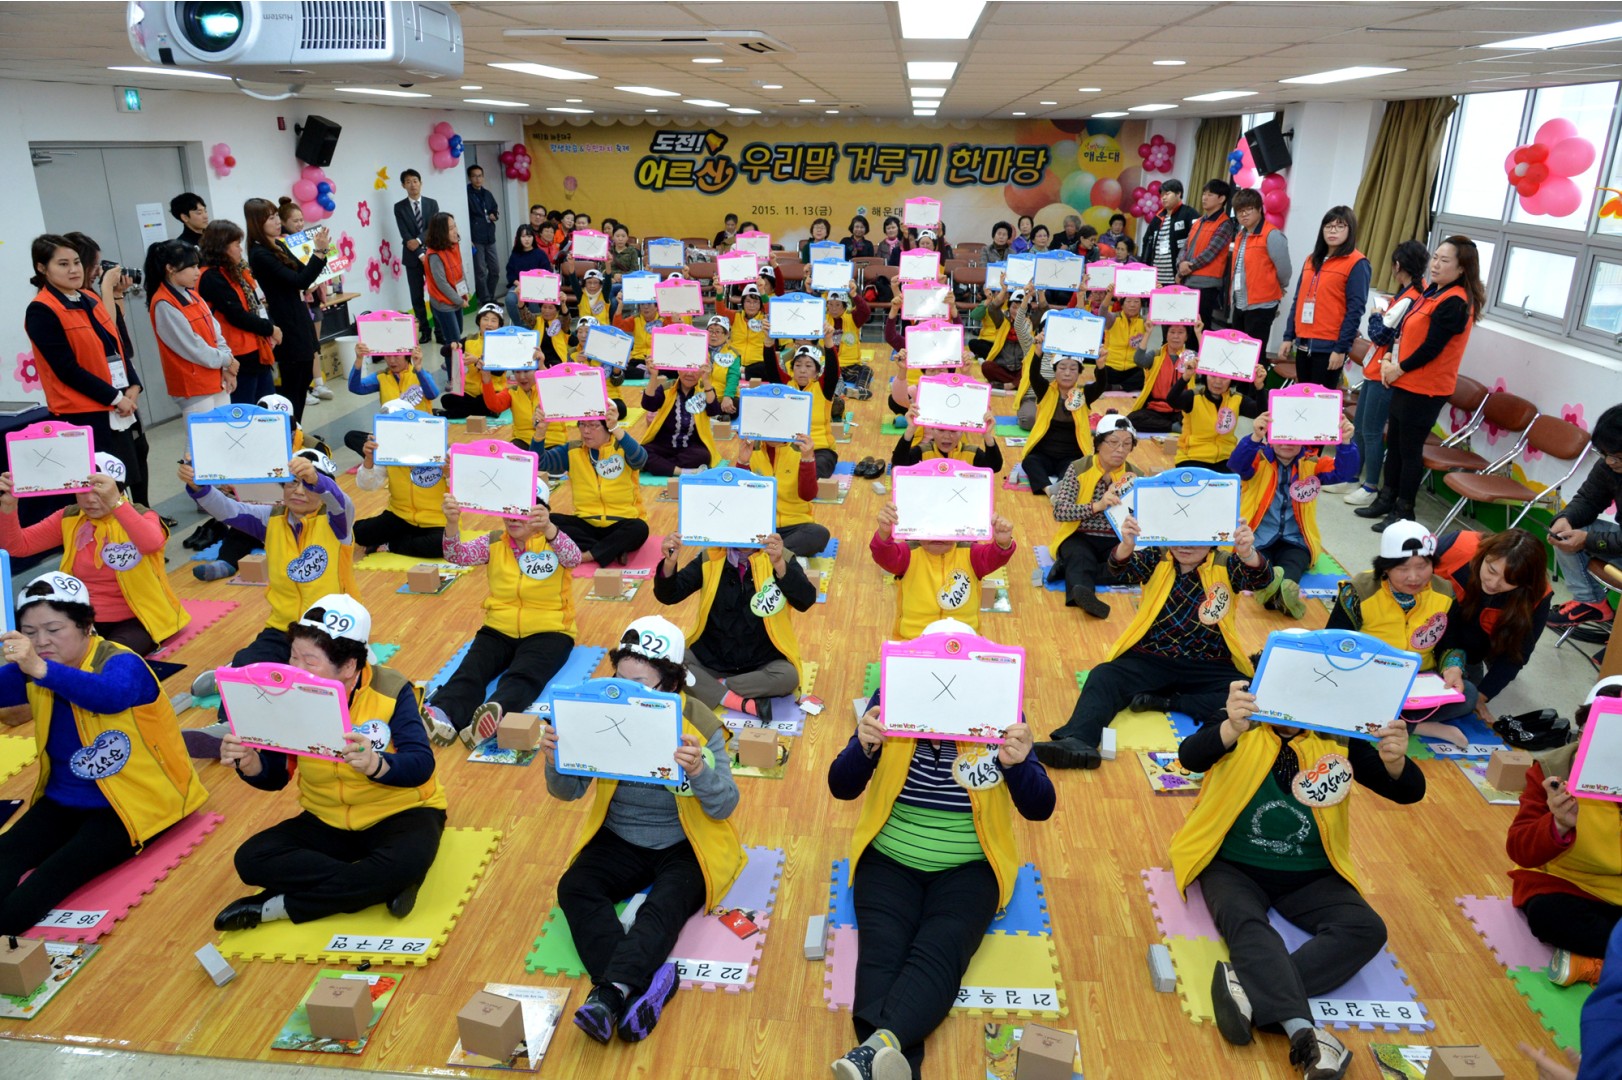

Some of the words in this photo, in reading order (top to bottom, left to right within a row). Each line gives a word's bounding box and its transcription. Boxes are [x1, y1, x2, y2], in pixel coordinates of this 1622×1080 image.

[652, 133, 706, 152] 도전!
[637, 159, 735, 192] 어르신
[741, 146, 838, 181] 우리말
[847, 147, 940, 182] 겨루기
[949, 146, 1048, 184] 한마당
[751, 205, 780, 216] 2015.
[803, 204, 833, 217] 13(금)
[107, 463, 123, 476] 44
[57, 577, 79, 592] 36
[325, 614, 350, 632] 29
[641, 634, 664, 654] 22
[77, 913, 100, 925] 36
[331, 936, 394, 951] 김구연
[402, 941, 426, 952] 29
[720, 966, 743, 980] 22
[1032, 992, 1052, 1006] 21
[1318, 1001, 1391, 1018] 권갑연
[1397, 1006, 1411, 1019] 8
